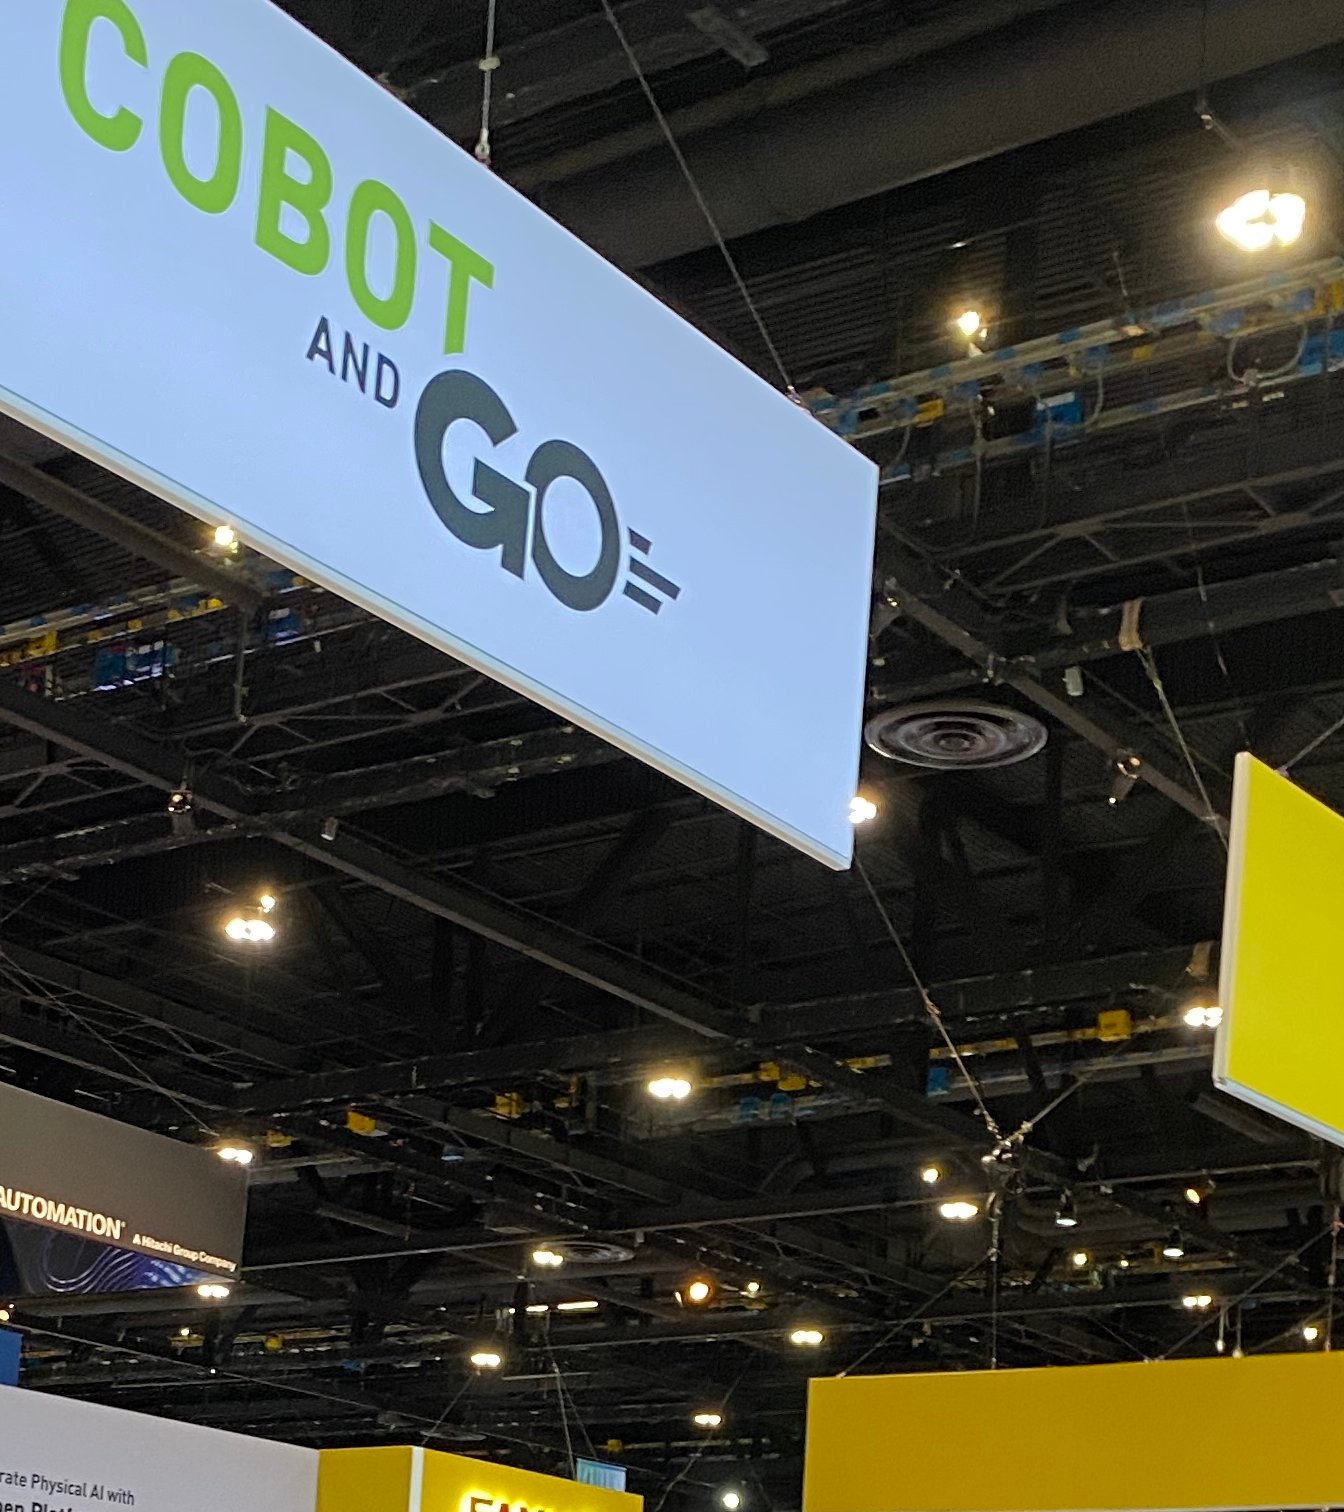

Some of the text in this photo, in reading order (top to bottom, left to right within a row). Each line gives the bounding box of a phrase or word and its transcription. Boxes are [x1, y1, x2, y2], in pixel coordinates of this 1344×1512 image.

[60, 0, 495, 356] COBOT
[305, 315, 622, 612] AND GO
[173, 1243, 199, 1262] Group
[199, 1252, 237, 1272] Company
[31, 1474, 88, 1498] Physical
[90, 1484, 104, 1501] AI
[107, 1488, 135, 1506] with
